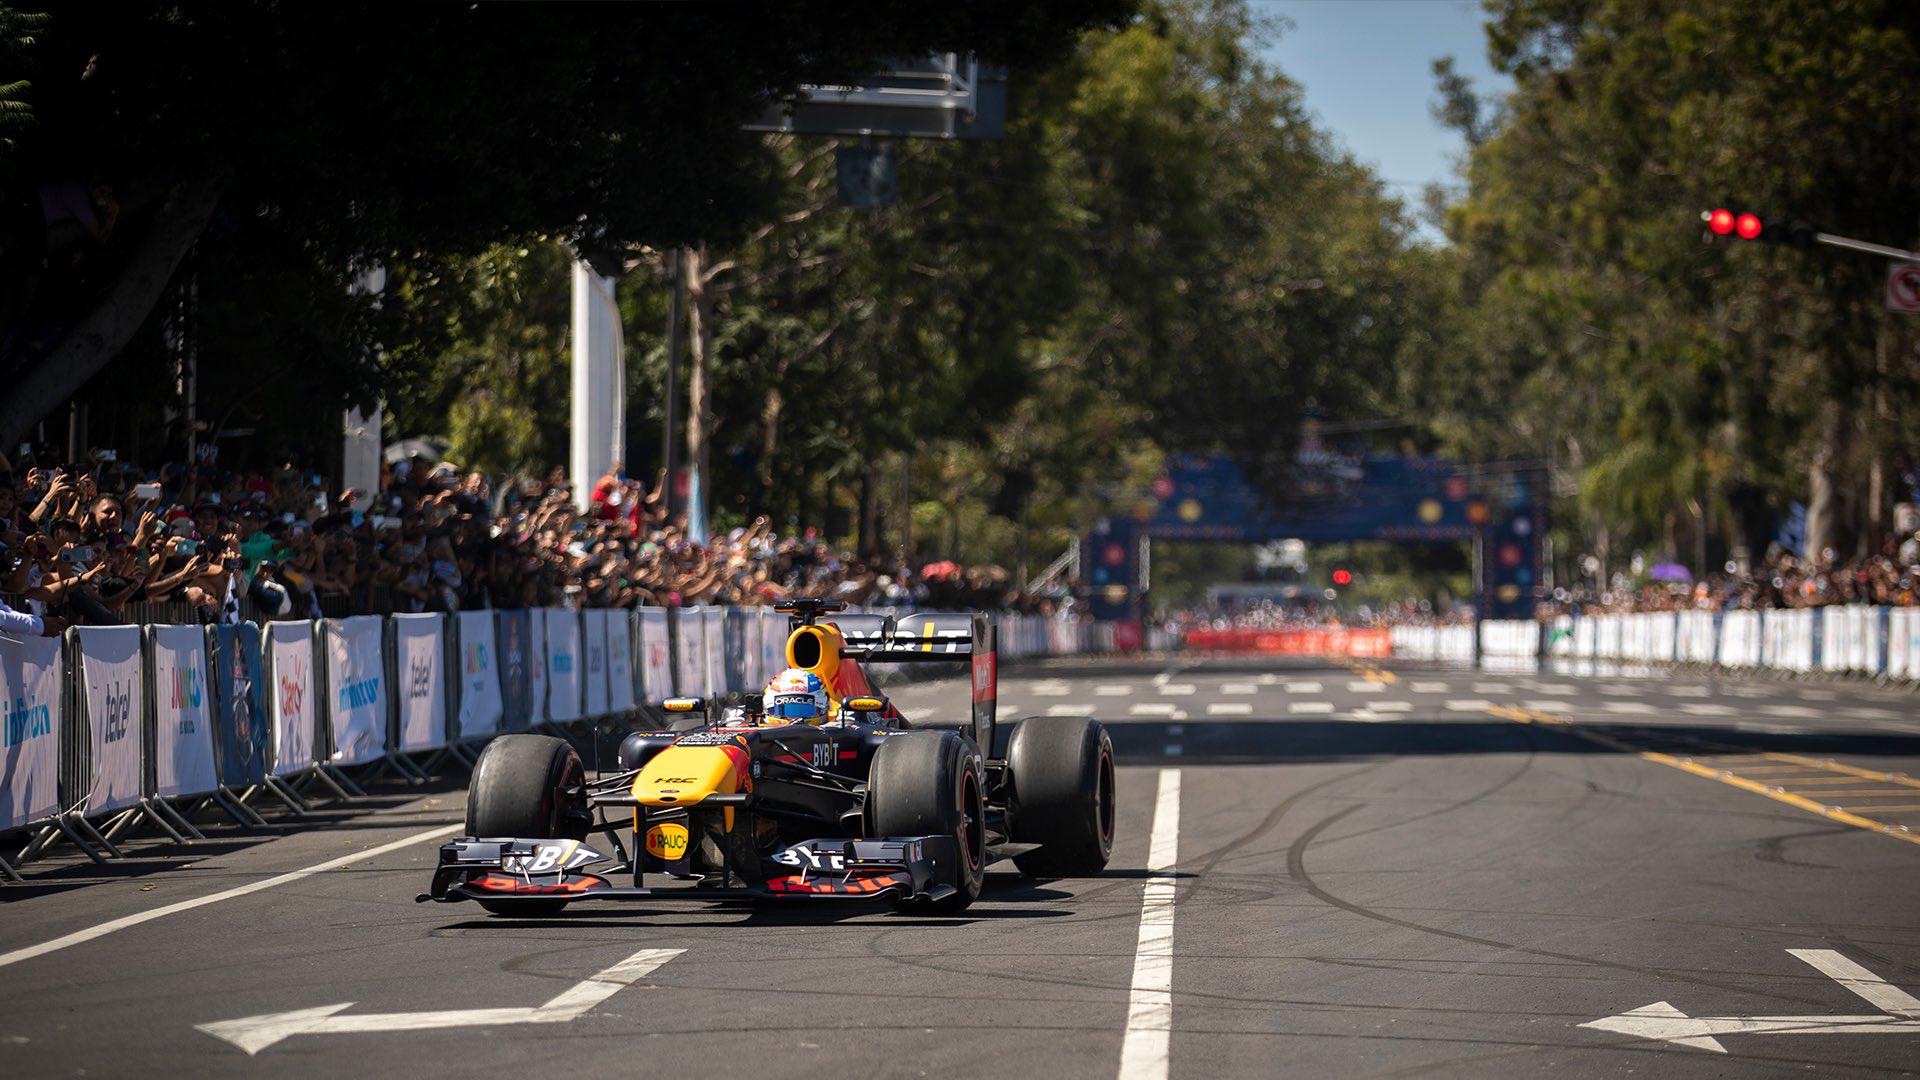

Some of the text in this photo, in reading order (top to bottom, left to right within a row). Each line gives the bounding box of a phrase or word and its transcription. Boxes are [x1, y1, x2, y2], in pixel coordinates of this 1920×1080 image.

[843, 622, 968, 653] YBIT
[105, 679, 130, 743] telcel
[775, 696, 814, 705] ORACLE
[813, 738, 839, 767] BYBIT
[508, 840, 600, 871] BIT
[658, 834, 688, 849] RAUCH
